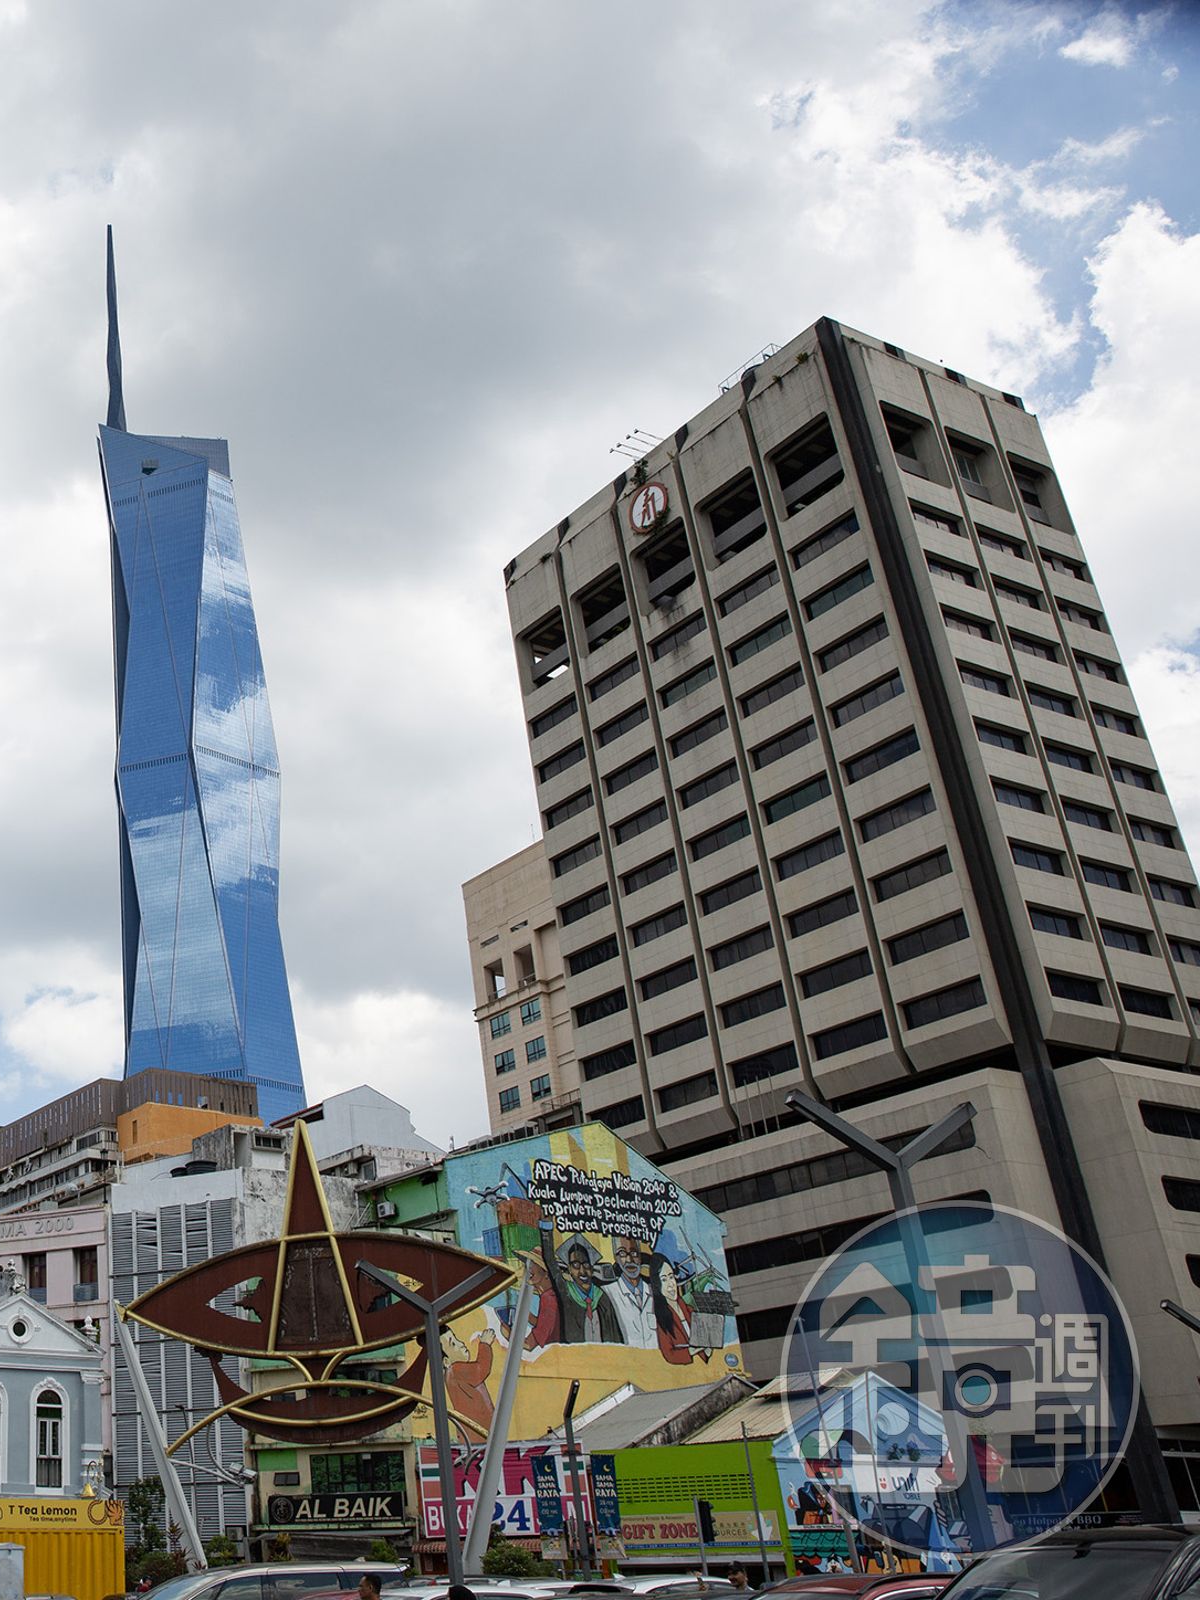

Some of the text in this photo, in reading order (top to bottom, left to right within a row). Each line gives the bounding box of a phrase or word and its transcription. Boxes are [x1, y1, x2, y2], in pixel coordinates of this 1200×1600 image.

[535, 1161, 679, 1199] APEC Putrajaya Vision 2040 &
[528, 1183, 682, 1215] Kuala Lumpur Declaration 2020
[556, 1216, 598, 1232] Shared
[603, 1208, 647, 1227] Principle
[34, 1217, 75, 1235] 2000
[536, 1488, 560, 1498] RAYA
[594, 1488, 617, 1498] RAYA
[8, 1505, 77, 1516] T Tea Lemon
[295, 1496, 392, 1519] AL BAIK
[1076, 1514, 1102, 1526] BBQ
[622, 1523, 656, 1539] GIFT
[659, 1522, 699, 1539] ZONE
[714, 1528, 748, 1537] OURCES
